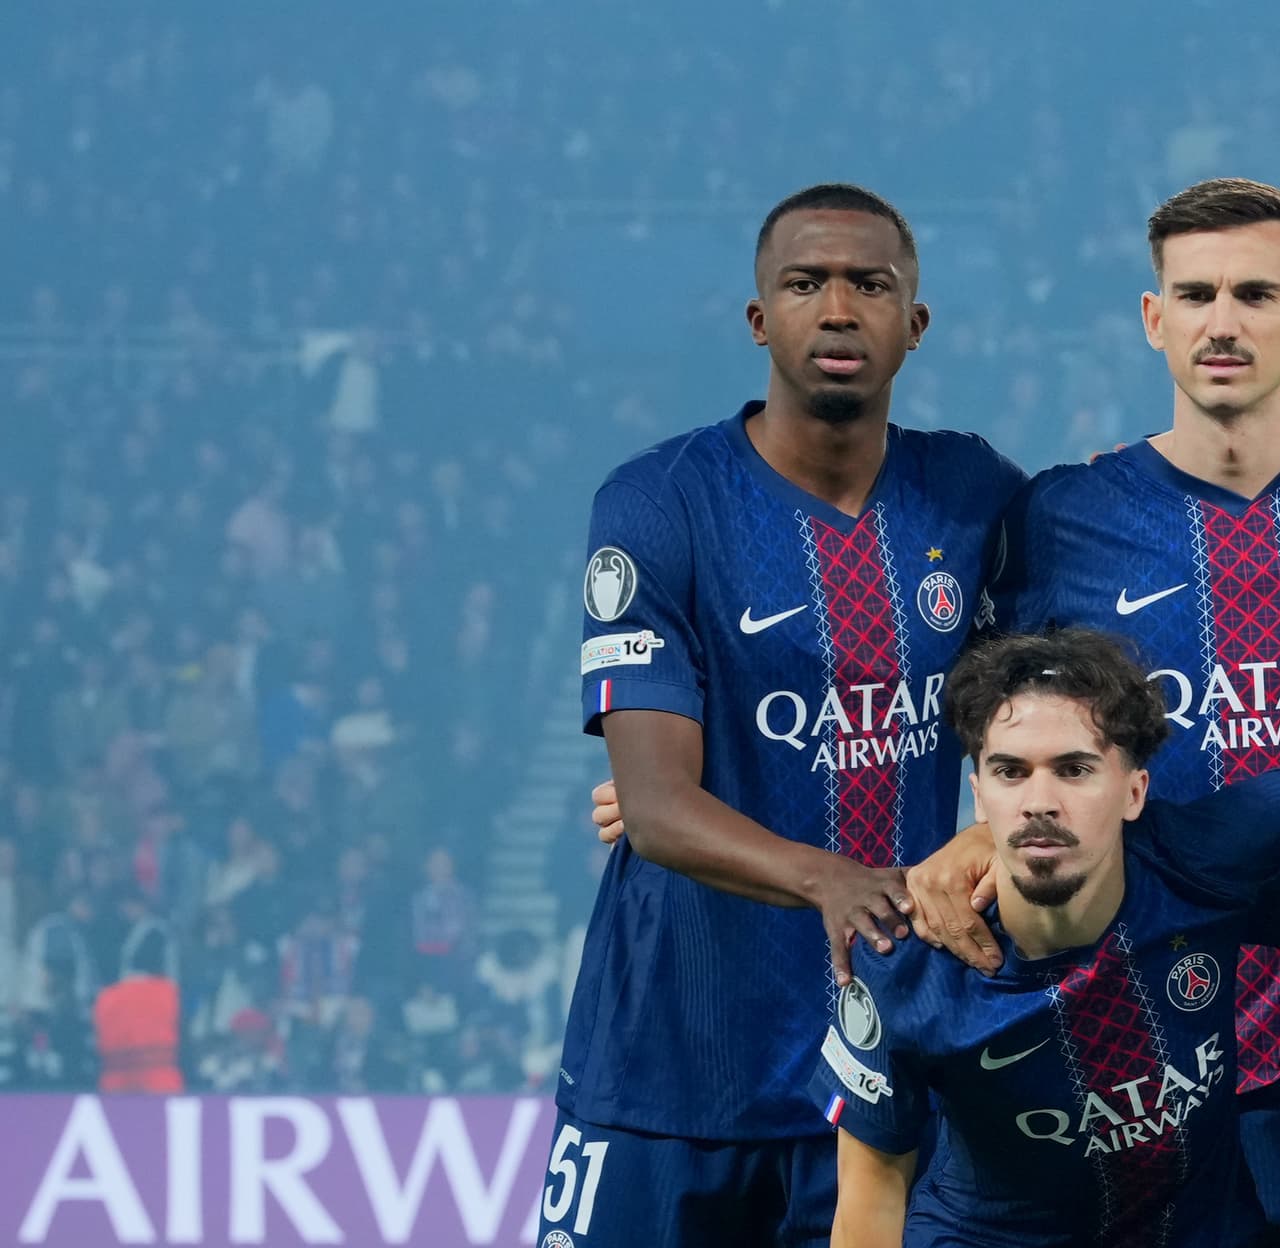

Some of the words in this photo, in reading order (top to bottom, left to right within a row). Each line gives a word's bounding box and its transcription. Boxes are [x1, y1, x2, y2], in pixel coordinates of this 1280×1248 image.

[924, 575, 954, 591] PARIS
[756, 672, 945, 751] QATAR
[810, 721, 939, 772] AIRWAYS
[1171, 956, 1205, 980] PARIS
[1015, 1031, 1224, 1146] QATAR
[1084, 1063, 1224, 1158] AIRWAYS
[17, 1095, 544, 1243] AIRW
[543, 1123, 609, 1236] 51
